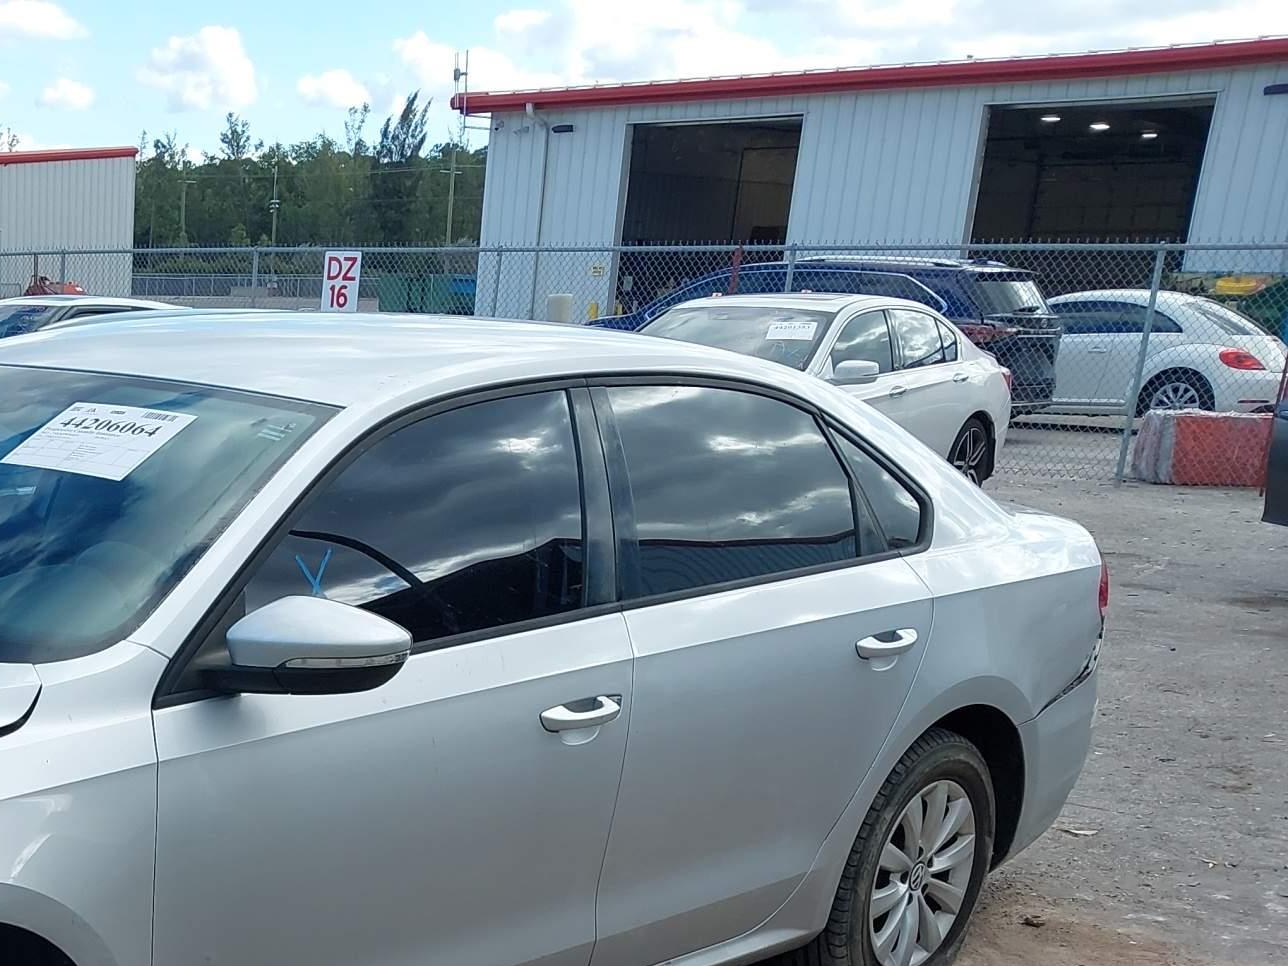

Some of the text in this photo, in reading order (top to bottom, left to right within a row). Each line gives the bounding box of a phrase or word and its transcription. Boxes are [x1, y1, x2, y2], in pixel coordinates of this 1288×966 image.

[327, 256, 358, 282] DZ
[329, 284, 348, 309] 16
[60, 416, 163, 438] 44206064
